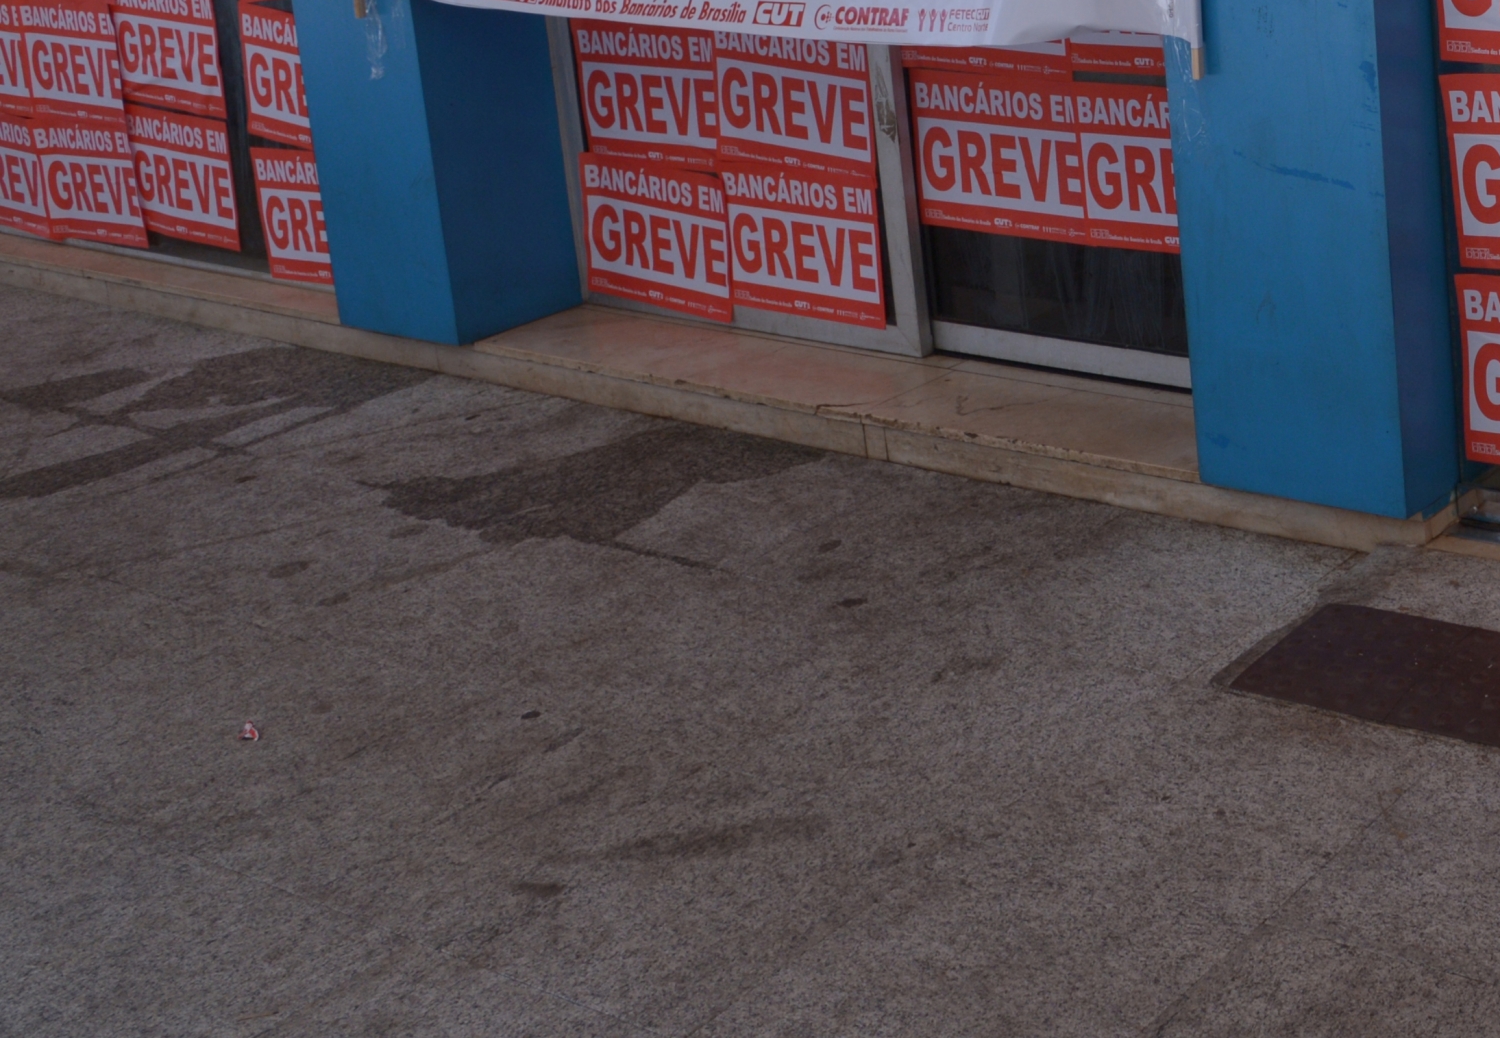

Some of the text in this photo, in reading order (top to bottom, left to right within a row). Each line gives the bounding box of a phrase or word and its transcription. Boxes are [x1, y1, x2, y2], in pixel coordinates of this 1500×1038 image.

[21, 6, 96, 32] BANCÁRIOS
[243, 13, 297, 48] BANCÁ
[679, 0, 696, 20] de
[699, 0, 747, 24] Brasília
[754, 2, 805, 26] CUT
[835, 6, 909, 27] CONTRAF
[32, 40, 122, 100] GREVE
[119, 20, 219, 87] GREVE
[578, 30, 711, 61] BANCÁRIOS EM
[837, 42, 866, 71] EM
[586, 68, 717, 138] GREVE
[722, 67, 868, 150] GREVE
[916, 83, 1042, 120] BANCÁRIOS
[1081, 94, 1170, 128] BANCÁR
[34, 129, 112, 151] BANCÁRIOS
[207, 130, 226, 152] EM
[48, 160, 141, 217] GREVE
[136, 150, 234, 219] GREVE
[585, 165, 722, 211] BANCÁRIOS EM
[723, 165, 872, 214] BANCÁRIOS EM
[923, 127, 1083, 206] GREVE
[266, 195, 326, 253] GRE
[592, 204, 727, 286] GREVE
[733, 213, 876, 292] GREVE
